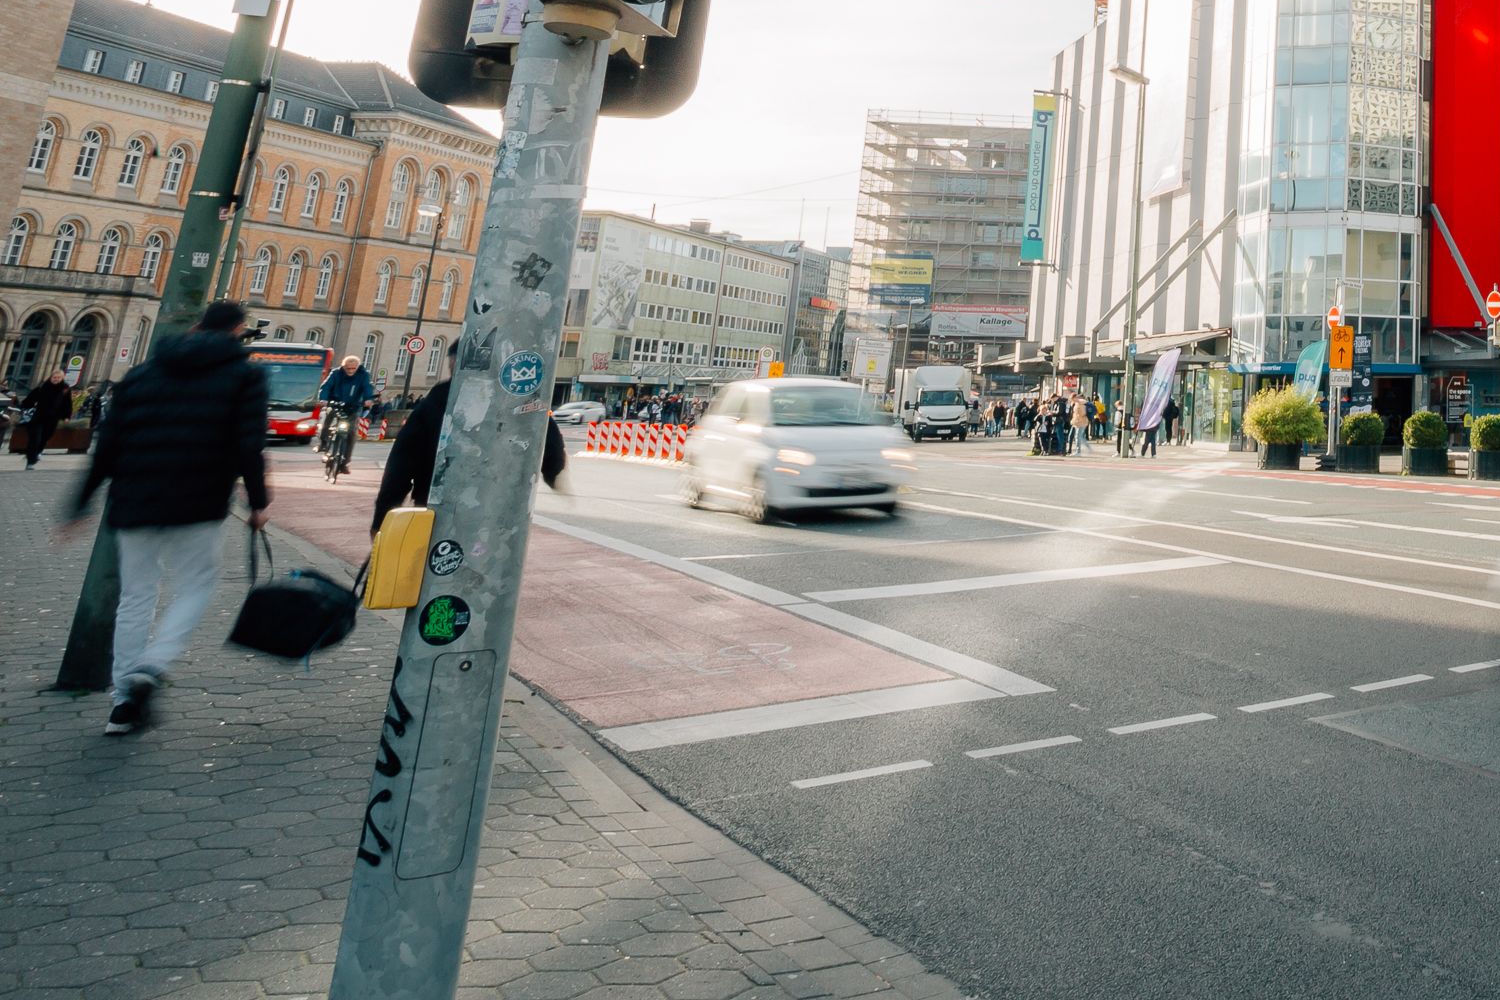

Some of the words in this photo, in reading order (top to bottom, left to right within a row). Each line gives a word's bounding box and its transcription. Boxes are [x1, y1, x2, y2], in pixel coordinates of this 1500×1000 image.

[1032, 141, 1041, 176] quartier
[979, 317, 1013, 326] Kallage
[411, 341, 422, 350] 30
